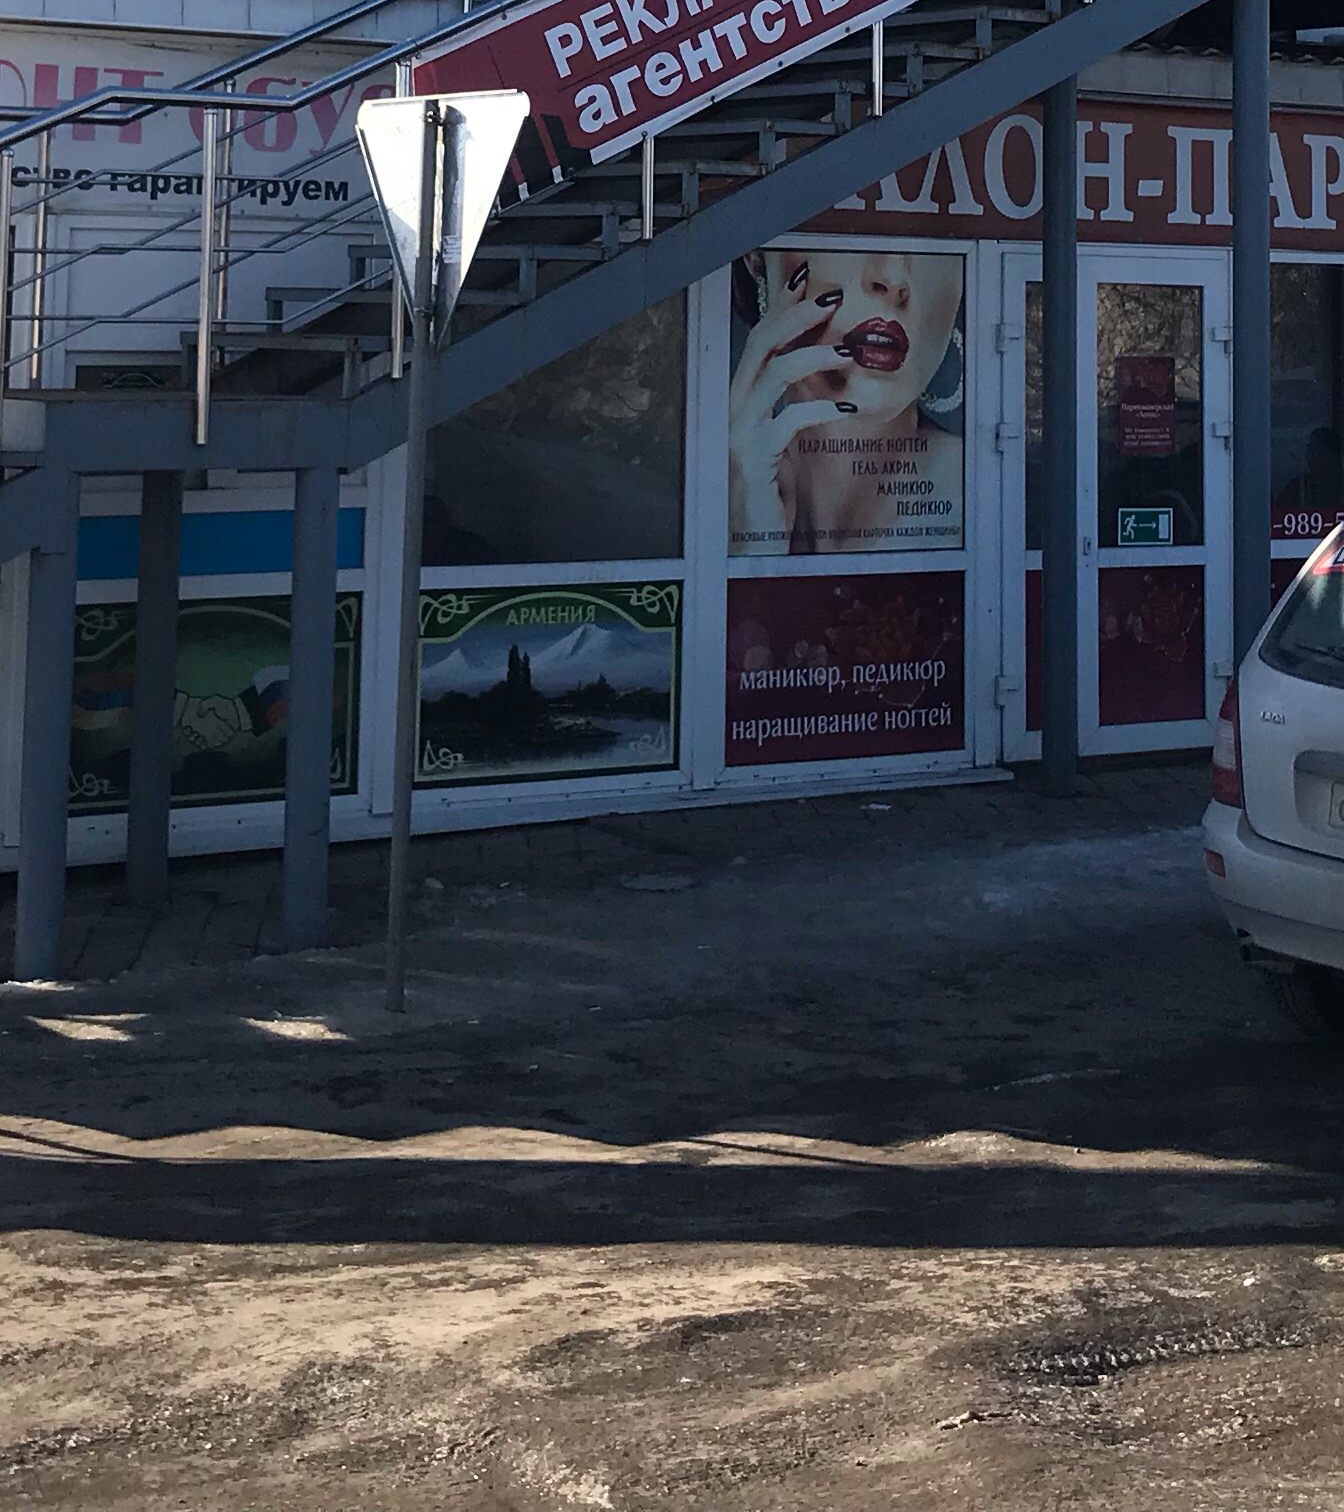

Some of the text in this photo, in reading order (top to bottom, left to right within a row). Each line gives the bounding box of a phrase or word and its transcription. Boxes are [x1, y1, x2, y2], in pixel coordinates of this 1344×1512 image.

[188, 77, 397, 156] обу
[798, 438, 883, 455] НАРАЩИВАНИЕ
[852, 459, 918, 476] ГЕЛЬ АКРИЛ
[876, 480, 935, 497] МАНИКЮР
[896, 500, 953, 517] ПЕДИКЮР
[506, 604, 596, 626] АРМЕНИЯ
[739, 659, 946, 693] маникюр, педикюр
[732, 702, 951, 747] наращивание ногтей
